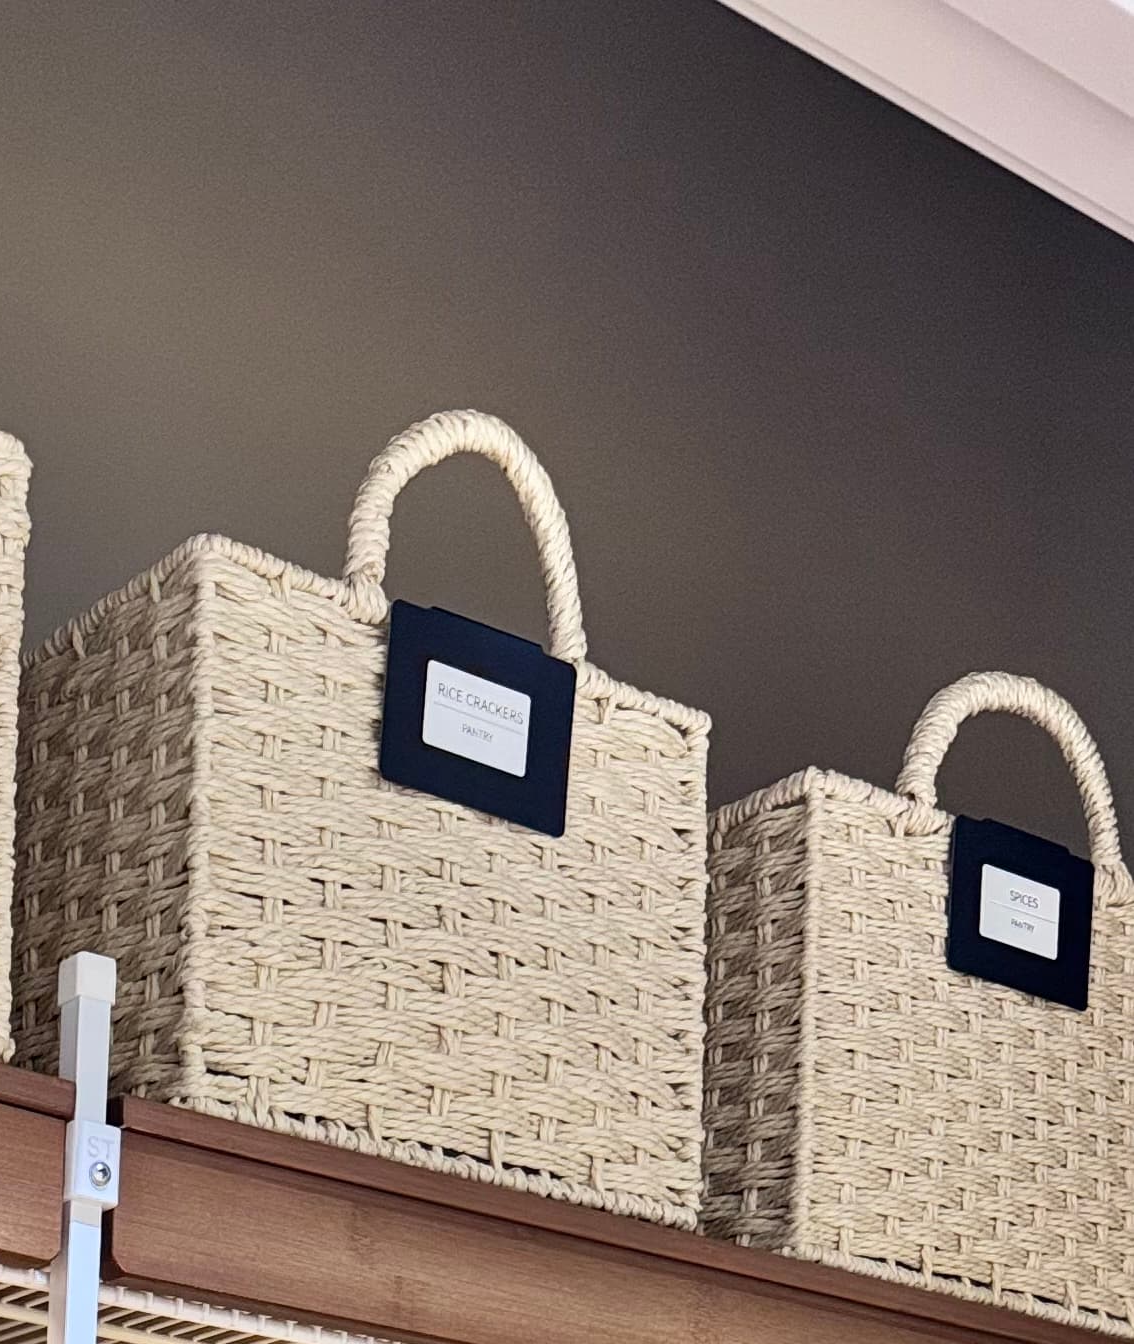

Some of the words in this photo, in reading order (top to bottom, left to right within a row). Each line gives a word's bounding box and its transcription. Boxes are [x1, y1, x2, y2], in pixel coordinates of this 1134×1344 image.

[437, 682, 463, 703] RICE
[466, 693, 525, 725] CRACKERS
[462, 723, 494, 742] PANTRY
[1009, 889, 1039, 909] SPICES
